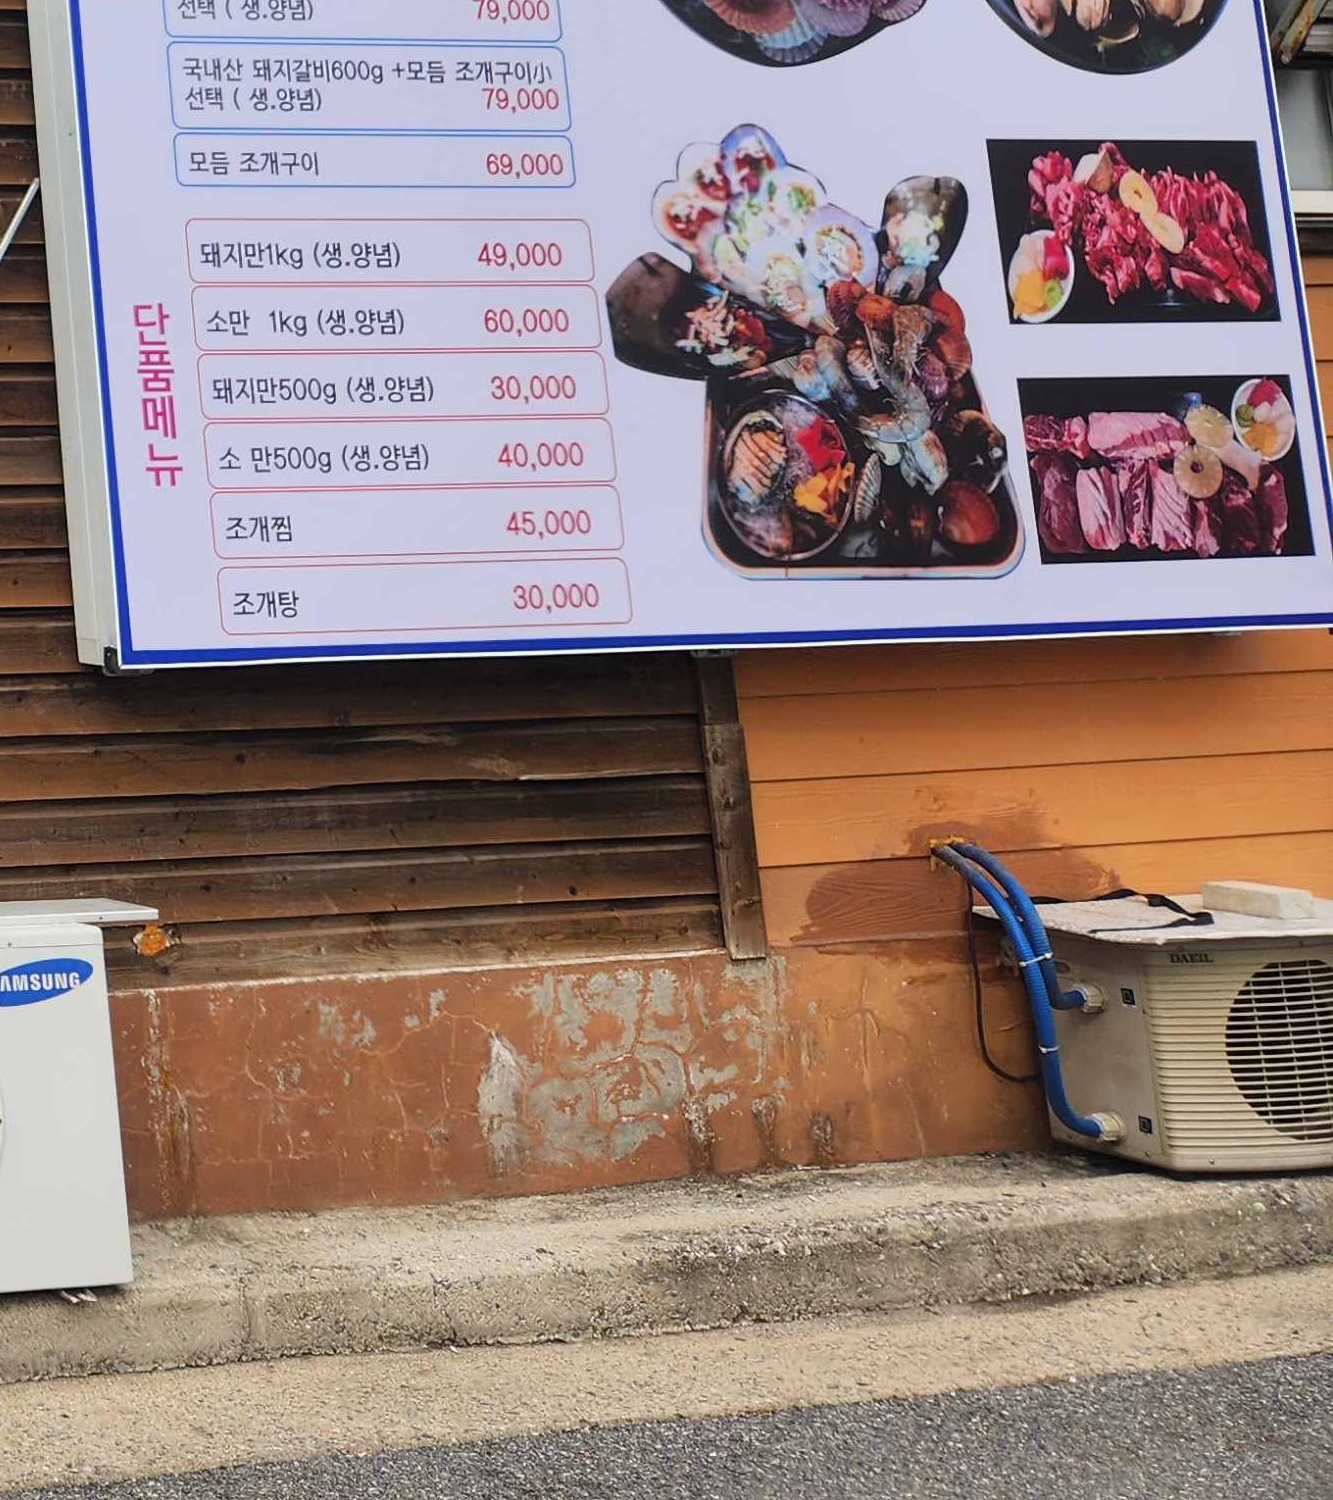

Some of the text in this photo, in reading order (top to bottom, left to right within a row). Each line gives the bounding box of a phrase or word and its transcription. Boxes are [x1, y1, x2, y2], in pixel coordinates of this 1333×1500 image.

[182, 57, 244, 82] 국내산
[184, 86, 224, 111] 선택
[481, 87, 560, 114] 79,000
[188, 151, 319, 176] 모듬 조개구이
[486, 153, 564, 180] 69,000
[313, 241, 401, 269] (생.양념)
[477, 242, 563, 271] 49,000
[206, 308, 405, 338] 소만 1kg (생.양념)
[483, 308, 570, 338] 60,000
[133, 302, 184, 488] 단품메뉴
[346, 375, 434, 404] (생.양념)
[490, 374, 577, 405] 30,000
[341, 443, 429, 473] (생.양념)
[497, 441, 584, 472] 40,000
[225, 515, 293, 543] 조개찜
[506, 509, 592, 540] 45,000
[233, 590, 300, 619] 조개탕
[513, 582, 600, 614] 30,000
[1168, 953, 1214, 964] DAEIL
